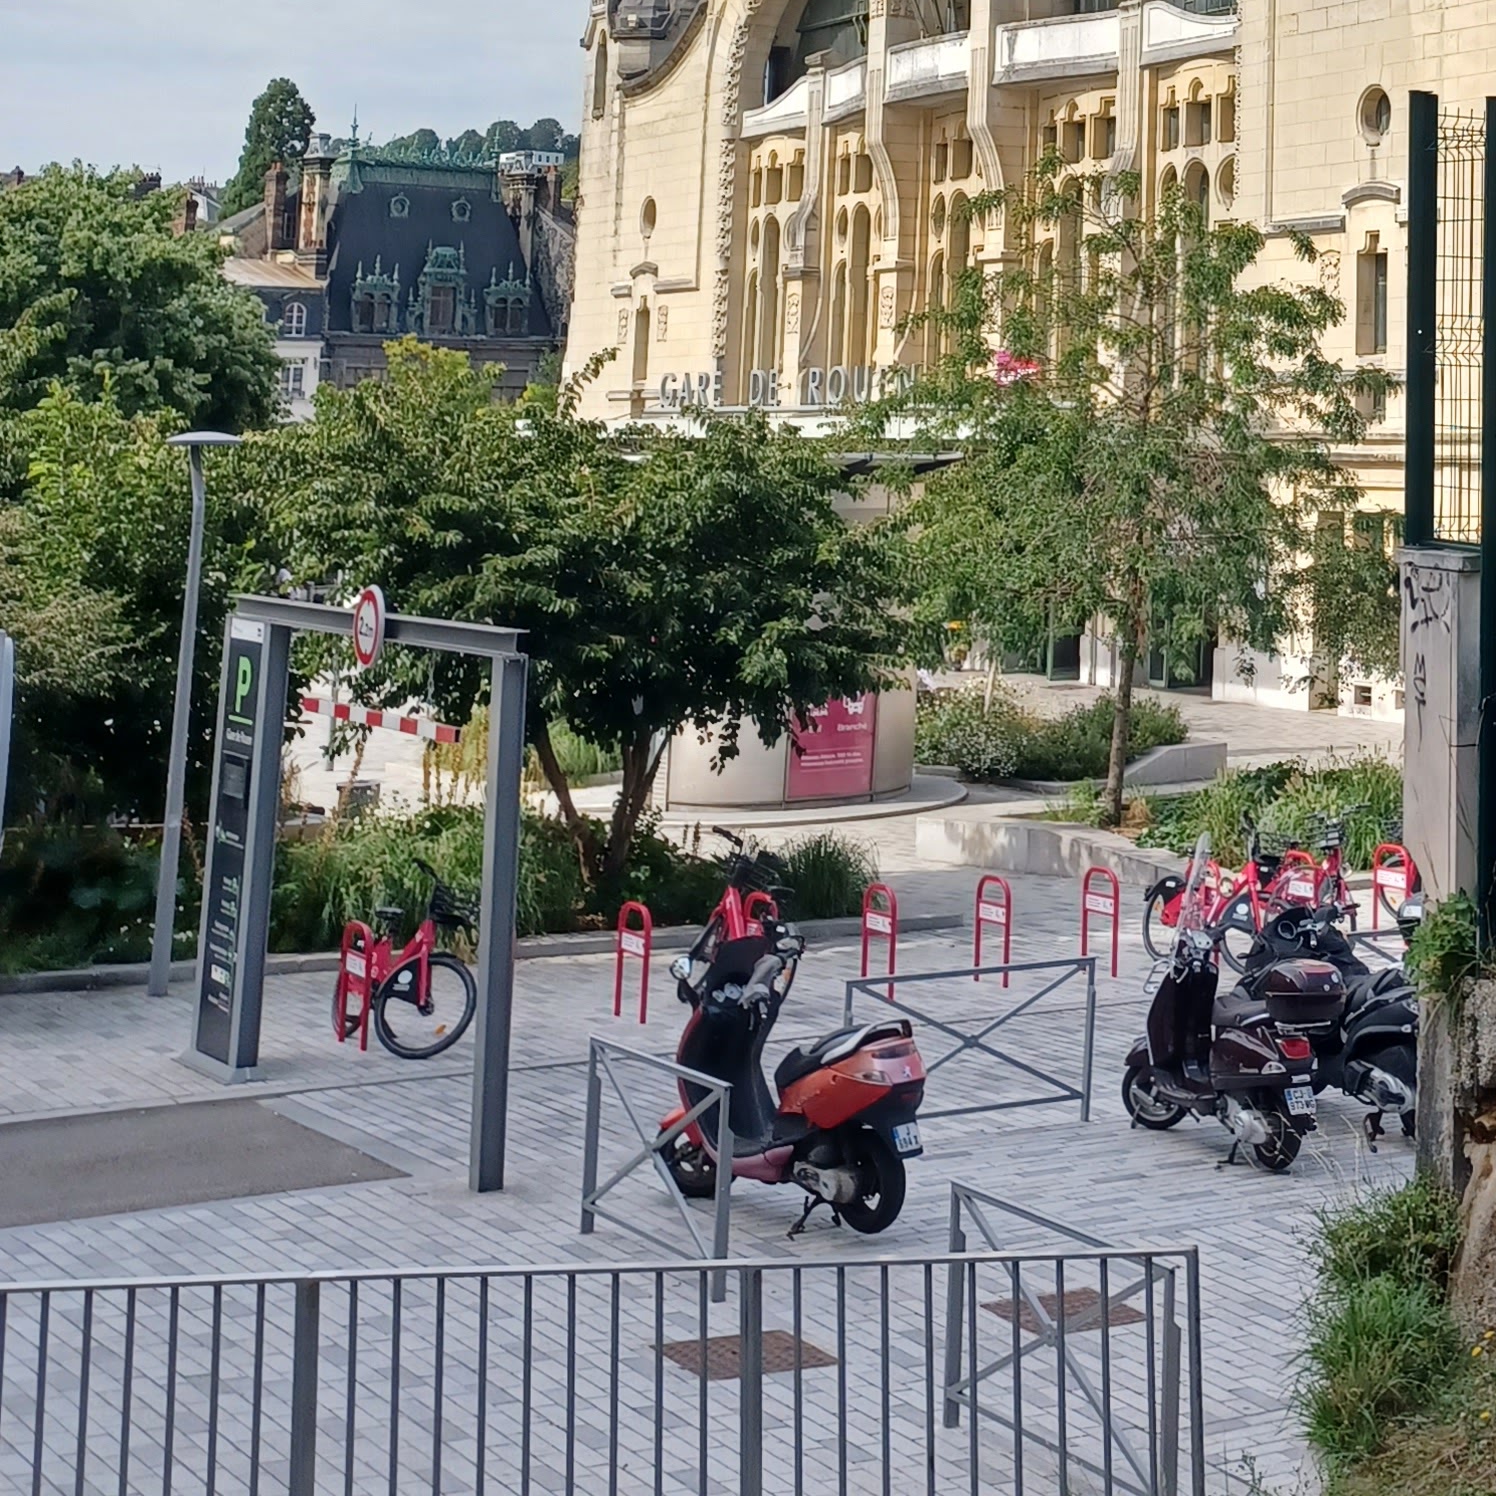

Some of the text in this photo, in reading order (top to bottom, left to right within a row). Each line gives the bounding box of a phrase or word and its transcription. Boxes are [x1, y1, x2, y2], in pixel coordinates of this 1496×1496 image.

[659, 370, 723, 408] GARE
[749, 368, 783, 407] DE
[235, 655, 252, 713] P
